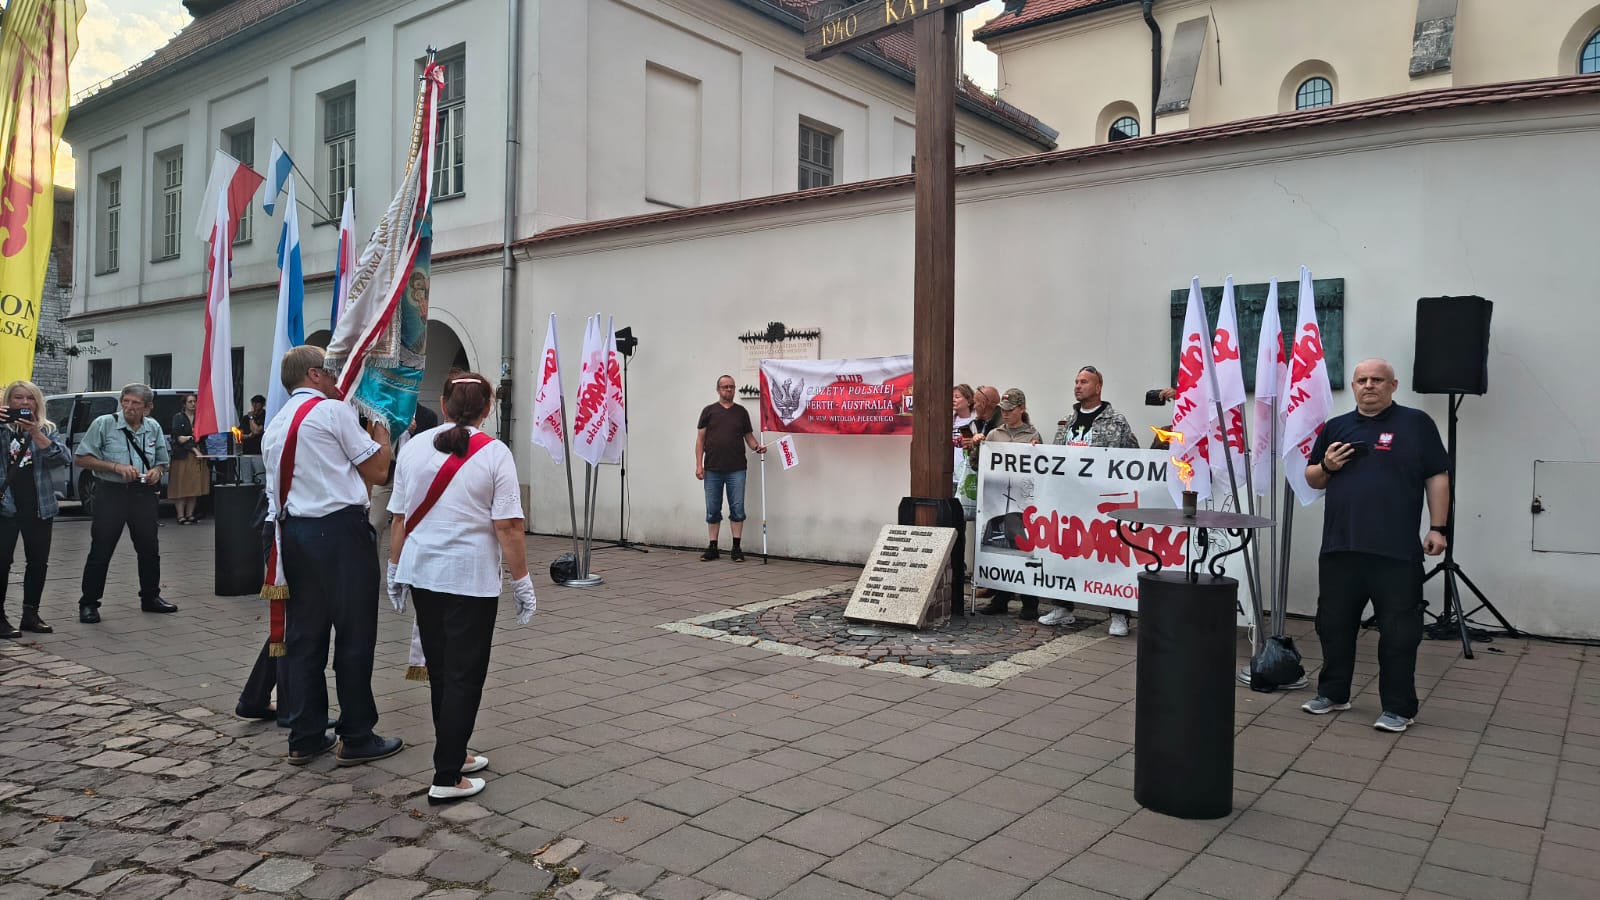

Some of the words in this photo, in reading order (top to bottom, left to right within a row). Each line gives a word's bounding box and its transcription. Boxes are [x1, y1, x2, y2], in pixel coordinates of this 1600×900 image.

[821, 13, 857, 46] 1940
[836, 375, 863, 383] KLUB
[848, 384, 895, 396] POLSKIEJ
[807, 400, 833, 410] PERTH
[841, 400, 893, 410] AUSTRALIA
[990, 452, 1066, 475] PRECZ
[1078, 458, 1095, 478] Z
[979, 566, 1025, 585] NOWA
[1033, 562, 1077, 592] HUTA
